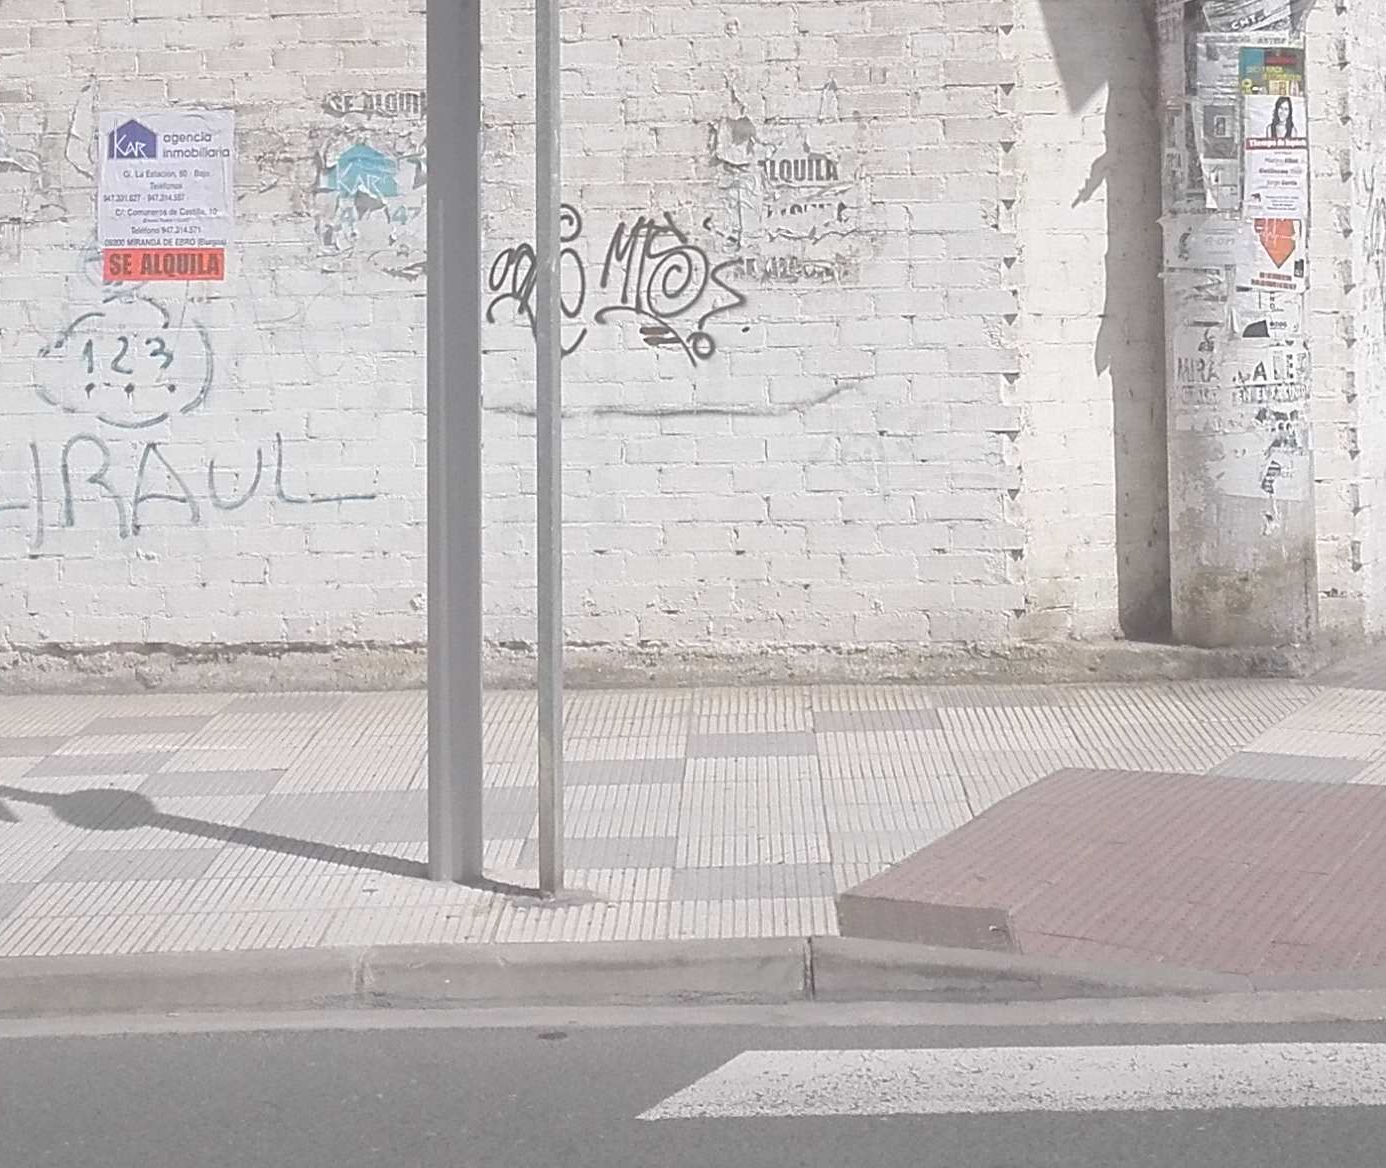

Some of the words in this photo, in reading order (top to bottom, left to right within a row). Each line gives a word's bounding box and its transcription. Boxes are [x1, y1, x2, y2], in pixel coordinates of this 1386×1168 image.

[113, 122, 148, 161] KAR
[163, 132, 212, 146] agencia
[162, 147, 231, 159] inmobiliaria
[126, 238, 161, 247] MIRANDA
[163, 238, 174, 247] DE
[175, 238, 196, 247] EBRO
[109, 253, 132, 276] SE
[140, 253, 220, 278] ALQUILA
